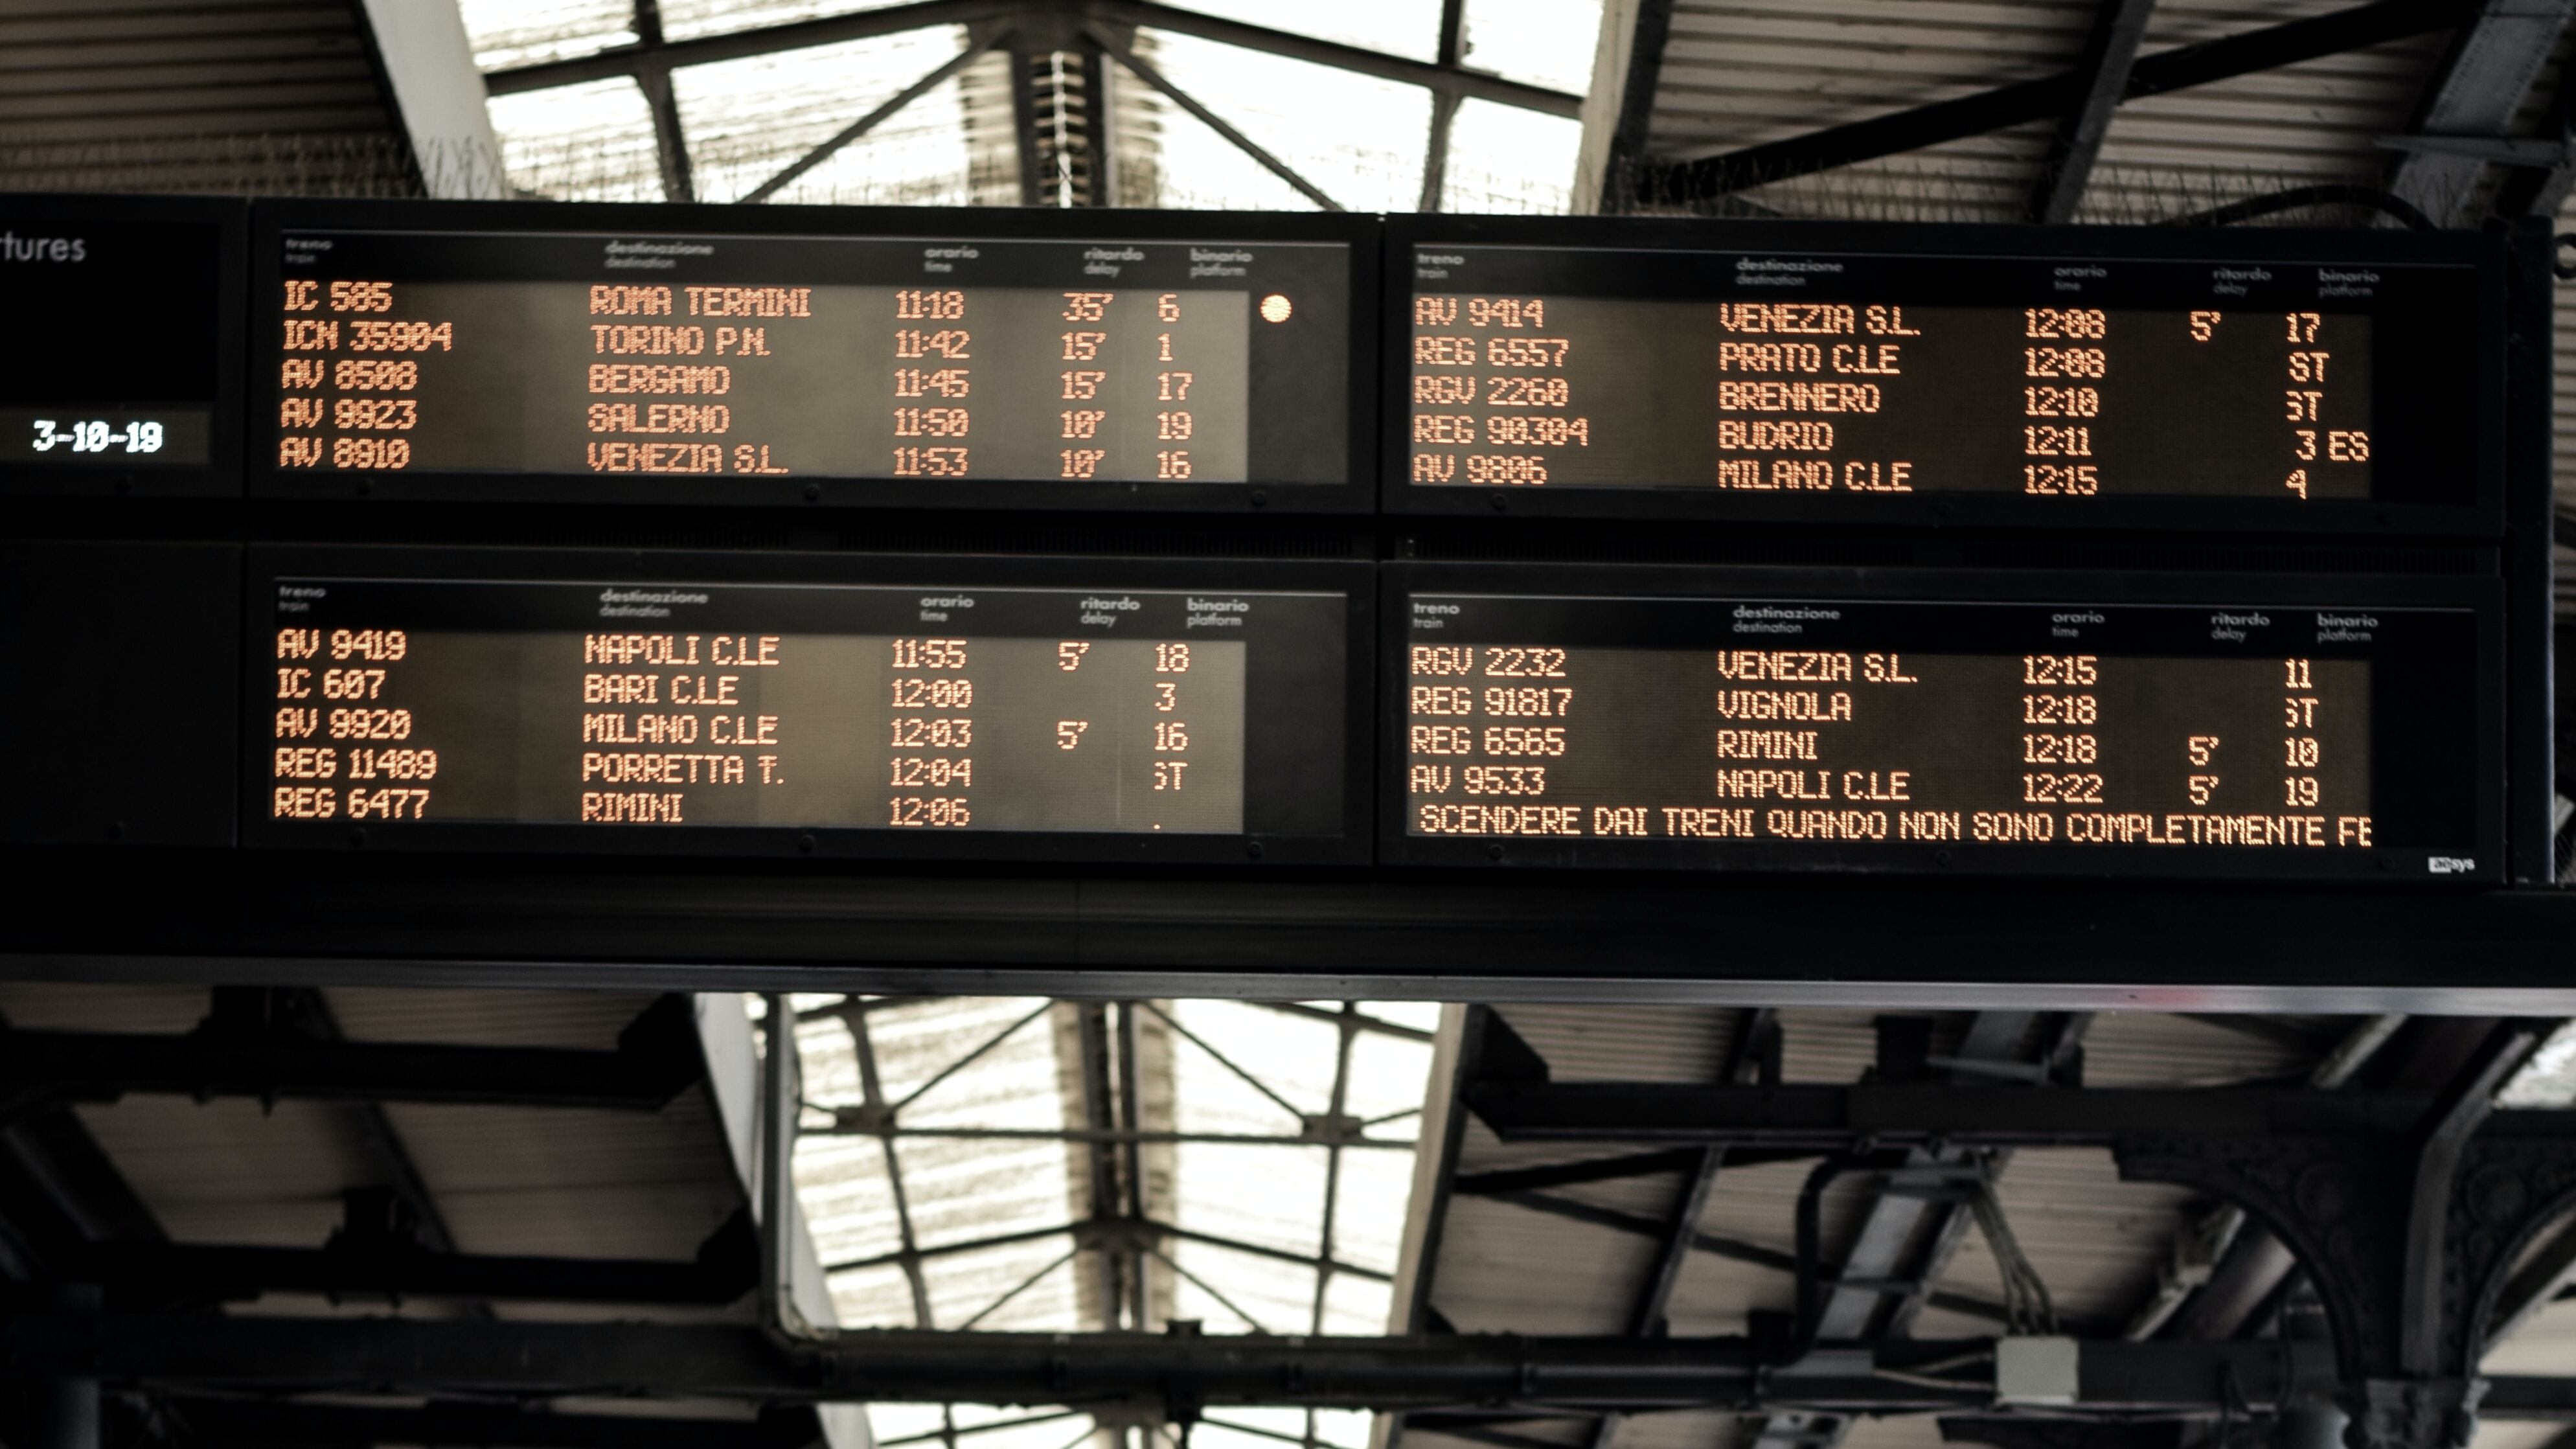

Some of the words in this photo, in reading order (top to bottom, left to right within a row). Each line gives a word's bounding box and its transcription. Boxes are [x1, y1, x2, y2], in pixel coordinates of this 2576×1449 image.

[1189, 247, 1253, 263] binario
[1416, 253, 1465, 266] treno
[1735, 257, 1845, 273] destinazione
[2318, 268, 2380, 283] binario
[284, 280, 319, 311] IC
[330, 281, 393, 312] 585
[589, 284, 672, 316] ROMA
[684, 286, 812, 318] TERMINI
[895, 290, 964, 320] 11:18
[1157, 293, 1181, 323] 6
[1415, 297, 1458, 326] AV
[1468, 297, 1544, 328] 9414
[1720, 302, 1855, 334] VENEZIA
[2025, 308, 2106, 339] 12:08
[2286, 312, 2321, 343] 17
[283, 319, 339, 350] ICN
[349, 321, 453, 352] 35904
[589, 324, 705, 356] TORINO
[895, 328, 971, 359] 11:42
[1157, 332, 1174, 362] 1
[1414, 336, 1477, 366] REG
[1487, 337, 1569, 368] 6557
[1719, 342, 1821, 373] PRATO
[2024, 347, 2106, 378] 12:08
[2288, 352, 2330, 382] ST
[281, 358, 325, 389] AV
[335, 359, 418, 391] 8508
[588, 363, 731, 395] BERGAMO
[894, 368, 970, 398] 11:45
[1157, 371, 1193, 402] 17
[1413, 375, 1477, 405] RGV
[1487, 376, 1569, 407] 2260
[1718, 381, 1880, 413] BRENNERO
[2024, 386, 2099, 417] 12:10
[32, 420, 163, 453] 3-10-19
[280, 397, 324, 429] AV
[334, 398, 417, 430] 9923
[587, 402, 731, 435] SALERNO
[893, 407, 970, 437] 11:50
[1156, 411, 1193, 440] 19
[1413, 414, 1476, 444] REG
[1486, 415, 1589, 447] 90304
[1718, 420, 1834, 451] BUDRIO
[2024, 426, 2092, 457] 12:11
[2296, 429, 2316, 461] 3
[2328, 431, 2369, 462] ES
[280, 437, 323, 468] AV
[333, 437, 411, 469] 8910
[587, 442, 723, 473] VENEZIA
[893, 446, 968, 477] 11:53
[1156, 450, 1192, 480] 16
[1413, 453, 1455, 483] AV
[1466, 454, 1548, 485] 9806
[1718, 459, 1834, 490] MILANO
[2023, 464, 2098, 496] 12:15
[599, 588, 709, 604] destinazione
[919, 594, 975, 608] orario
[1080, 595, 1141, 611] ritardo
[1186, 597, 1250, 613] binario
[919, 609, 948, 622] time
[1080, 611, 1117, 628] delay
[1186, 613, 1242, 629] platform
[1412, 602, 1461, 615] treno
[1732, 604, 1841, 620] destinazione
[2051, 611, 2106, 624] orario
[2211, 611, 2271, 626] ritardo
[2317, 612, 2379, 628] binario
[277, 628, 320, 659] AV
[330, 629, 407, 661] 9419
[584, 633, 701, 666] NAPOLI
[891, 638, 968, 670] 11:55
[1155, 643, 1191, 673] 18
[1412, 617, 1444, 629] train
[1732, 619, 1803, 634] destination
[2051, 626, 2079, 637] time
[2211, 627, 2247, 643] delay
[2317, 628, 2373, 644] platform
[1411, 646, 1474, 676] RGV
[1484, 647, 1566, 678] 2232
[1717, 650, 1852, 682] VENEZIA
[2023, 655, 2097, 685] 12:15
[2285, 658, 2312, 689] 11
[277, 668, 312, 698] IC
[323, 668, 386, 700] 607
[584, 673, 659, 704] BARI
[891, 678, 974, 709] 12:00
[1154, 681, 1177, 712] 3
[1411, 685, 1473, 716] REG
[1484, 687, 1573, 717] 91817
[1717, 690, 1852, 722] VIGNOLA
[2023, 694, 2097, 725] 12:18
[275, 707, 318, 738] AV
[329, 708, 411, 740] 9920
[582, 713, 699, 744] MILANO
[890, 717, 973, 749] 12:03
[1154, 721, 1189, 752] 16
[1410, 725, 1472, 755] REG
[1483, 726, 1566, 757] 6565
[1717, 729, 1818, 760] RIMINI
[2023, 733, 2097, 764] 12:18
[2285, 736, 2320, 768] 10
[275, 747, 337, 779] REG
[348, 748, 438, 780] 11489
[582, 752, 745, 784] PORRETTA
[890, 757, 972, 788] 12:04
[1410, 764, 1452, 793] AV
[1463, 766, 1545, 796] 9533
[1716, 769, 1831, 800] NAPOLI
[2023, 773, 2104, 804] 12:22
[2285, 776, 2320, 807] 19
[274, 786, 336, 818] REG
[348, 788, 430, 819] 6477
[582, 792, 684, 823] RIMINI
[889, 797, 971, 827] 12:06
[1419, 804, 1582, 835] SCENDERE
[1593, 806, 1648, 836] DAI
[1661, 807, 1755, 838] TRENI
[1767, 809, 1887, 839] QUANDO
[1899, 811, 1961, 841] NON
[1972, 812, 2054, 842] SONO
[2066, 812, 2325, 847] COMPLETAMENTE
